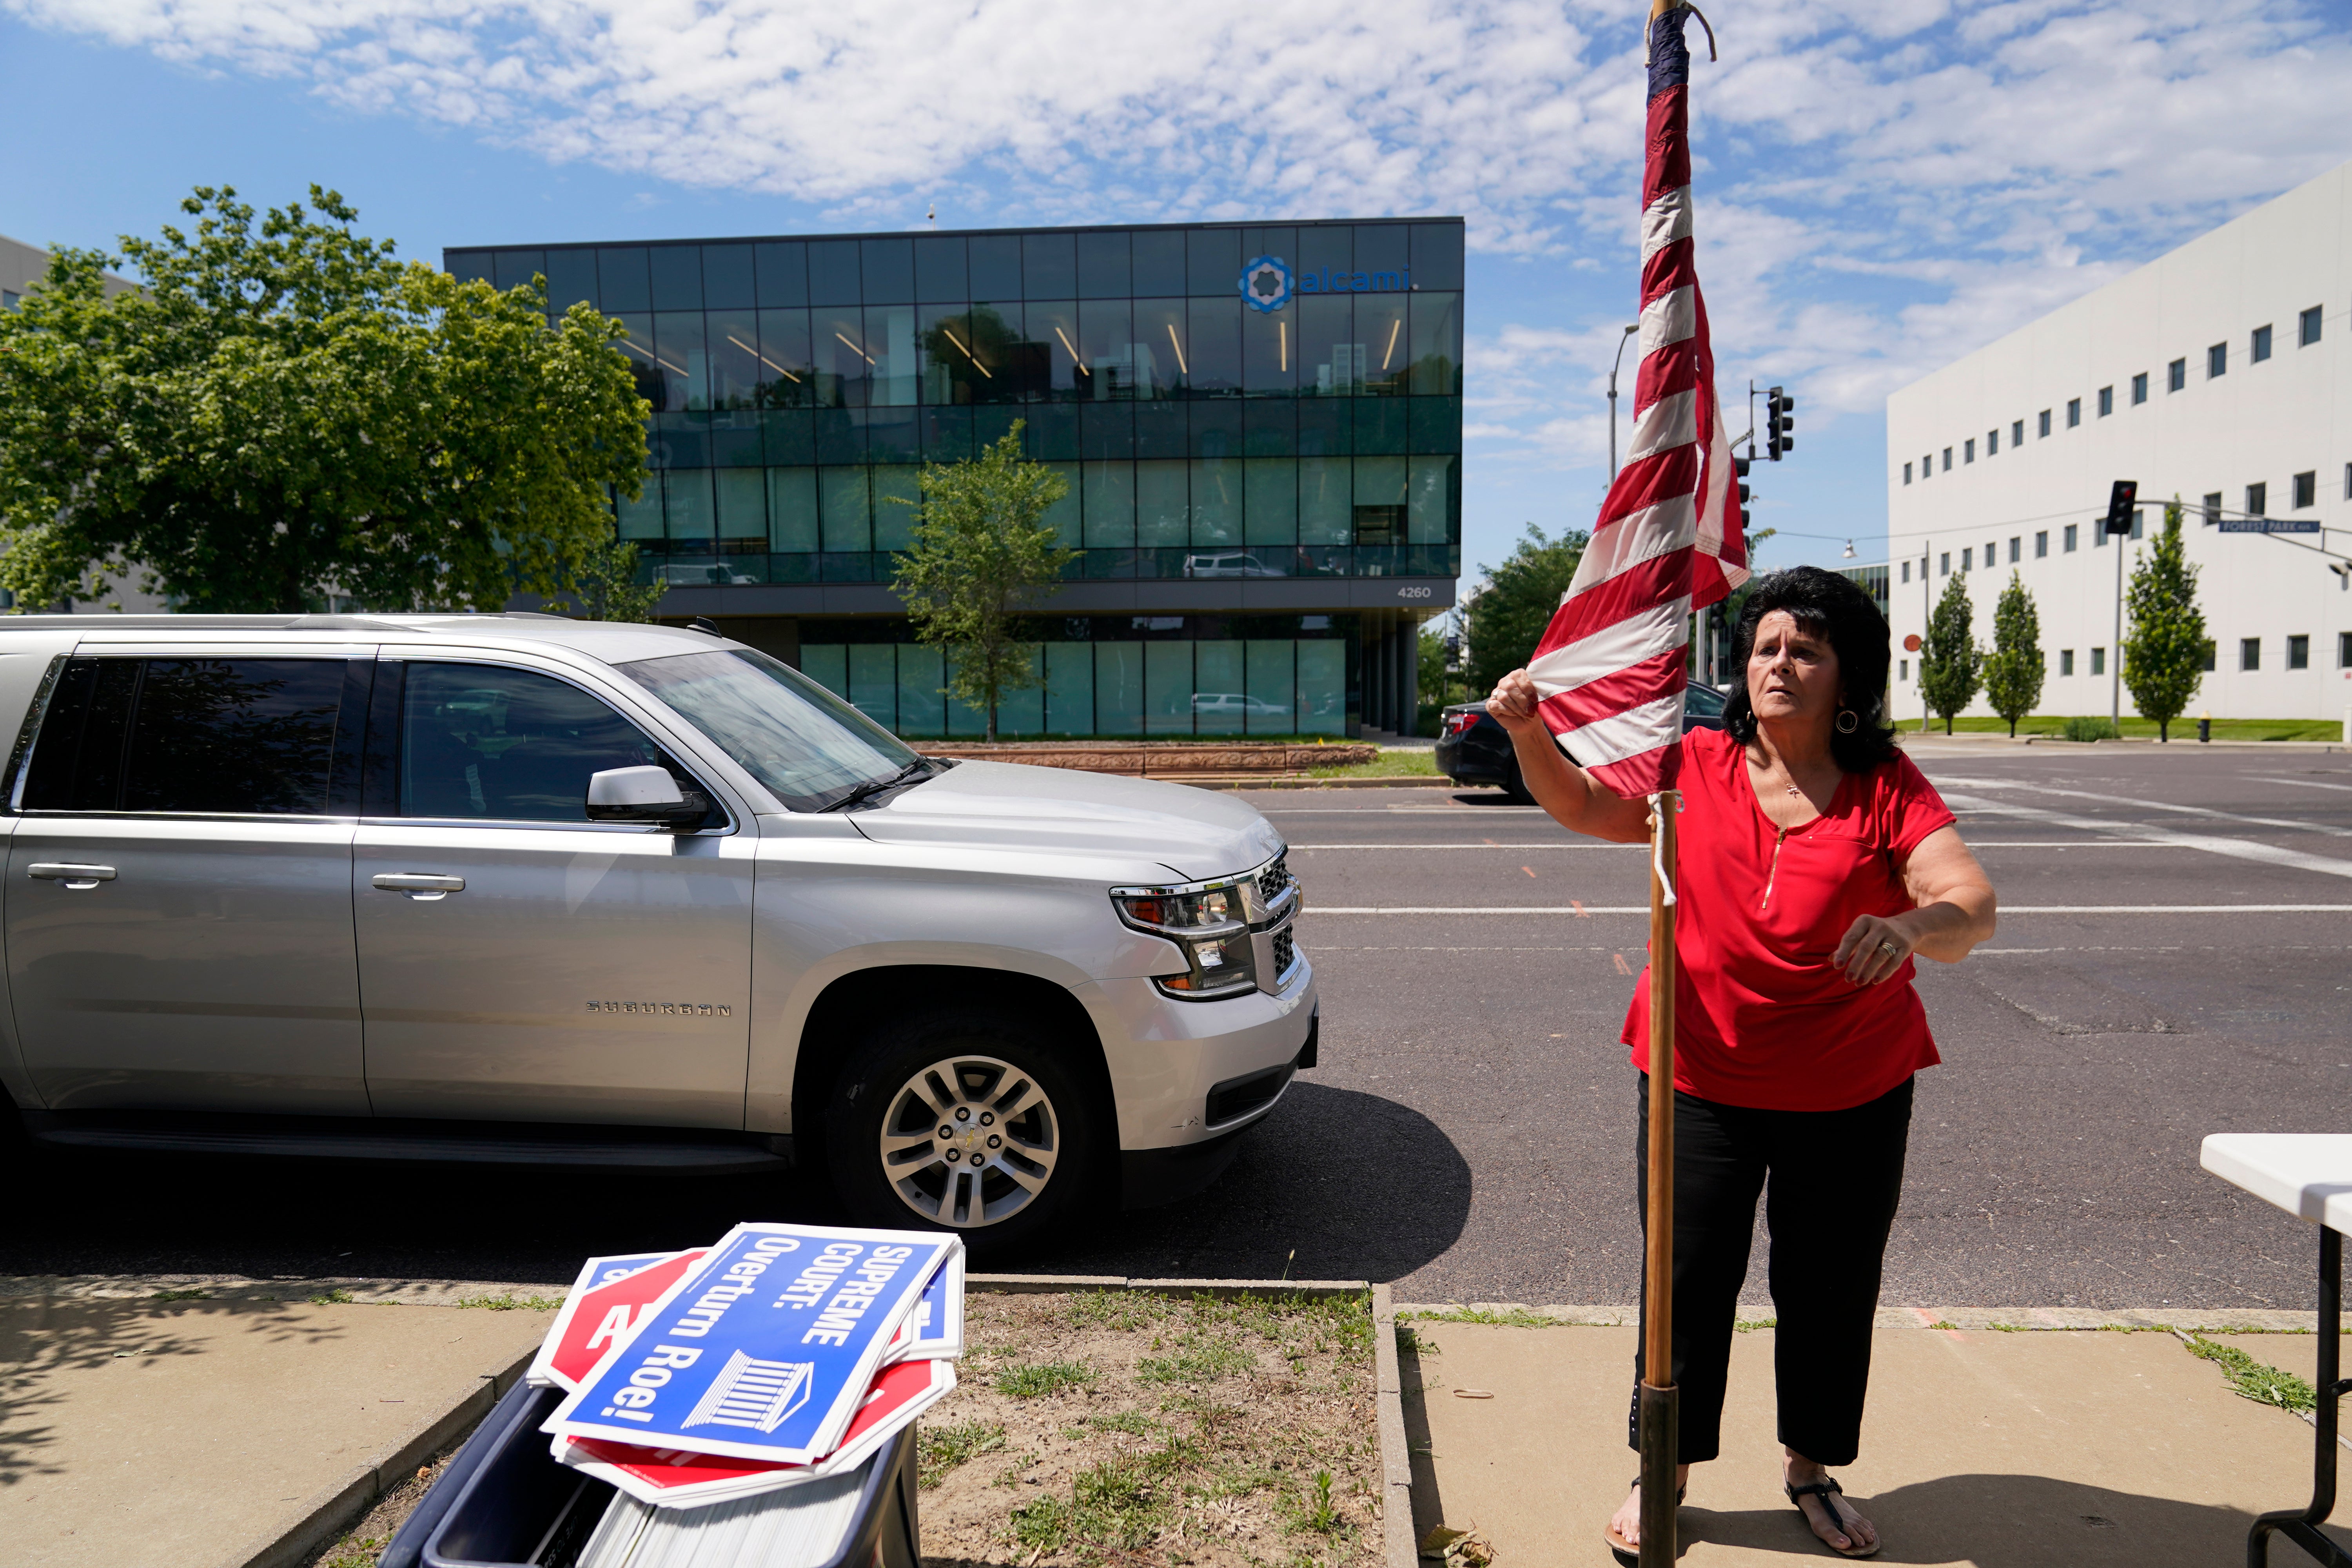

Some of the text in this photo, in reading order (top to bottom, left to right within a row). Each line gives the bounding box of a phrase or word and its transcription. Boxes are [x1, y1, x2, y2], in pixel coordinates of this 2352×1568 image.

[1300, 264, 1409, 292] alcami
[2223, 521, 2265, 532] FOREST
[2268, 521, 2296, 531] PARK
[1397, 587, 1431, 598] 4260
[586, 1001, 730, 1016] SUBURBAN
[669, 1237, 801, 1337] Overturn
[772, 1243, 864, 1309] COURT:
[801, 1245, 913, 1347] SUPREME
[601, 1345, 704, 1422] Roe!
